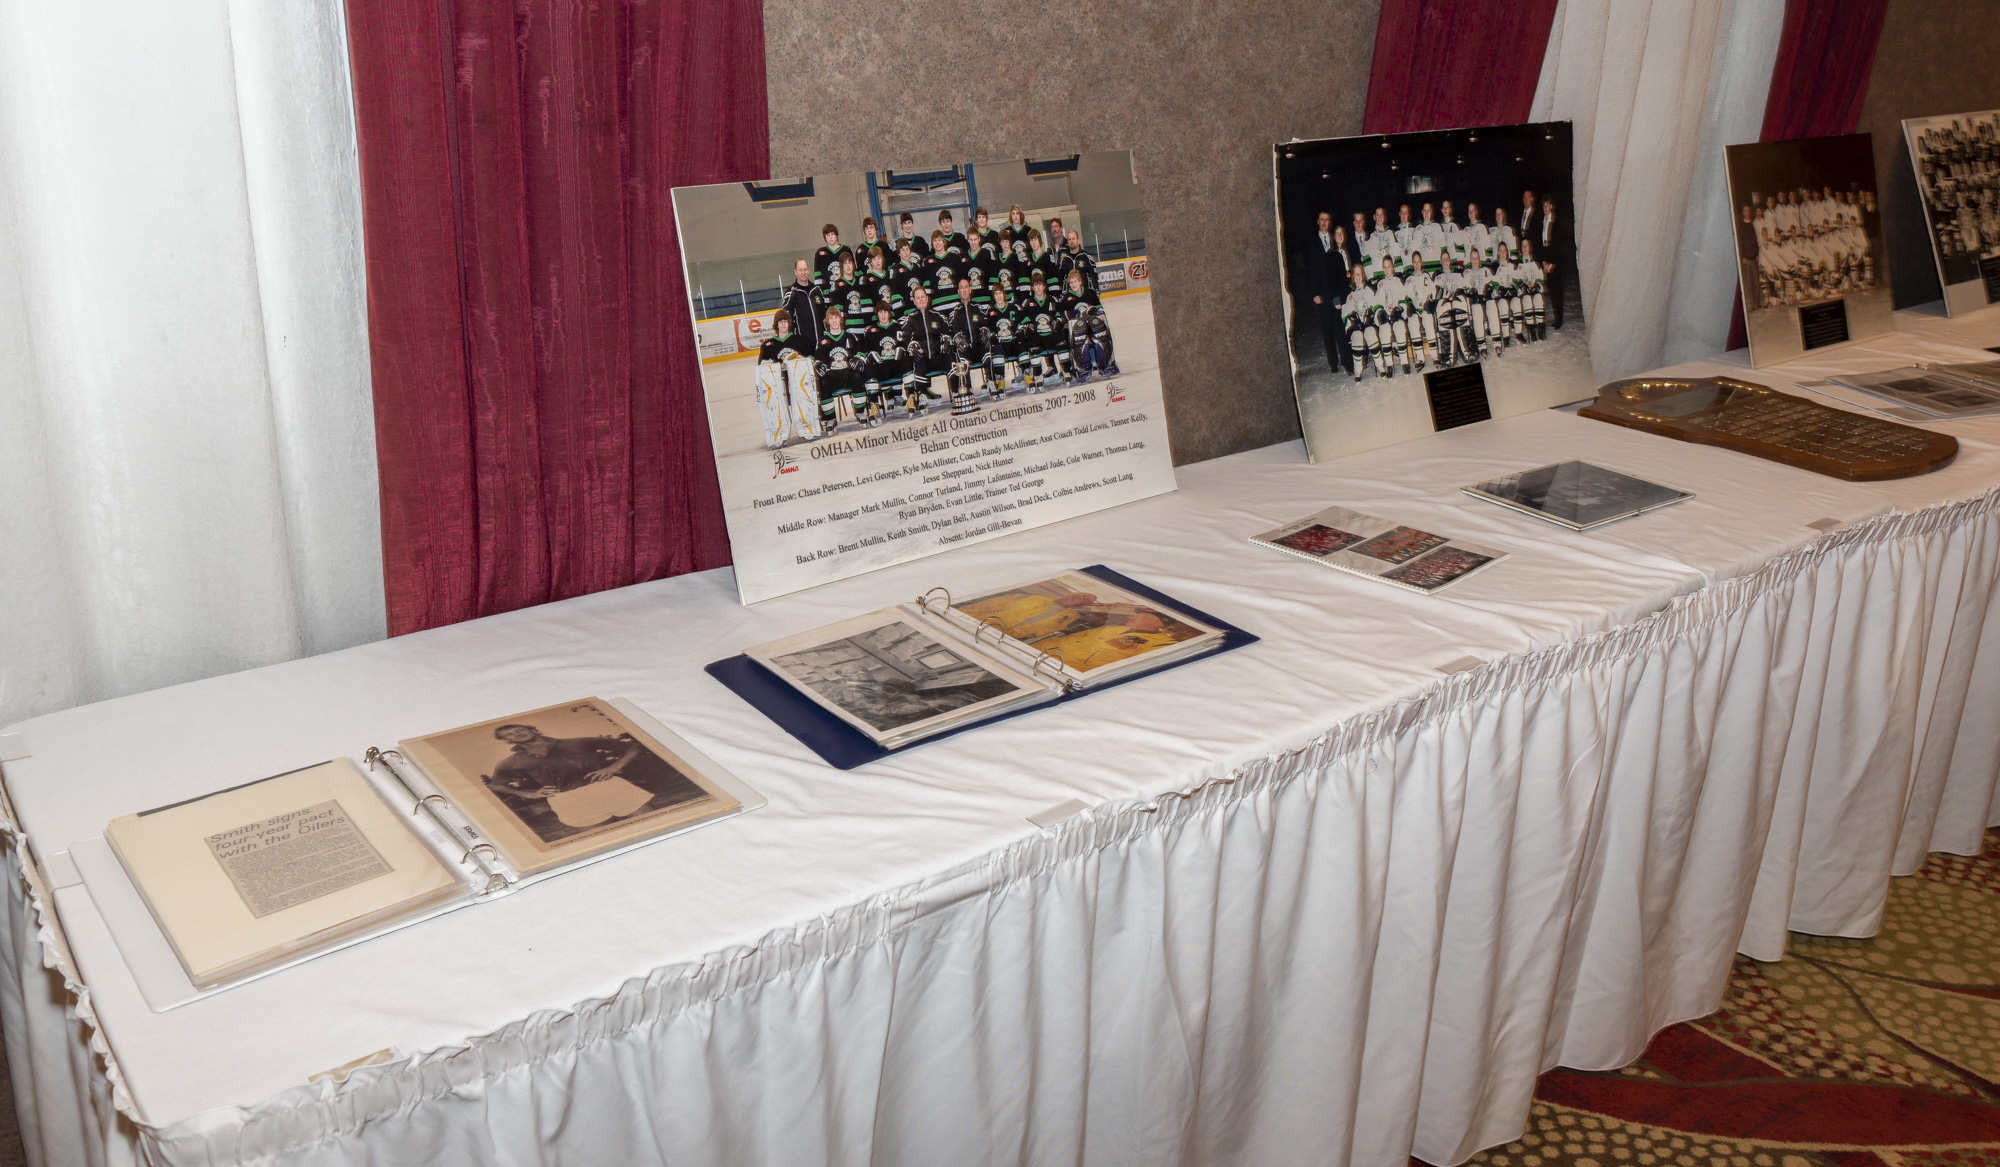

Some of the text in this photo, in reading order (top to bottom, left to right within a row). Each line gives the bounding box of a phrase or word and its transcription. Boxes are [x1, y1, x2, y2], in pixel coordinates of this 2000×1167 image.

[1010, 311, 1015, 320] C
[811, 444, 853, 459] OMHA
[855, 436, 889, 450] Minor
[891, 427, 929, 443] Midget
[931, 420, 947, 434] All
[950, 413, 987, 430] Ontario
[989, 404, 1043, 422] Champions
[1073, 390, 1095, 404] 2008
[921, 428, 1007, 454] Behan Construction
[754, 498, 774, 508] Front
[776, 494, 797, 503] Row:
[798, 488, 821, 498] Chase
[822, 481, 855, 493] Petersen,
[856, 476, 873, 485] Levi
[874, 470, 901, 481] George,
[903, 464, 919, 475] Kyle
[921, 457, 958, 470] McAllister,
[959, 450, 981, 461] Coach
[982, 446, 1001, 456] Randy
[1003, 439, 1038, 451] McAllister,
[1040, 435, 1052, 443] Asst
[1053, 430, 1073, 440] Coach
[1074, 425, 1089, 435] Todd
[1131, 414, 1147, 423] Kelly,
[780, 466, 799, 474] OMHA
[923, 475, 940, 484] Jesse
[941, 466, 974, 479] Sheppard,
[975, 462, 991, 470] Nick
[778, 521, 804, 533] Middle
[806, 519, 827, 527] Row:
[828, 509, 859, 522] Manager
[861, 503, 880, 514] Mark
[882, 498, 907, 509] Mullin,
[908, 491, 934, 502] Connor
[935, 483, 963, 496] Turland,
[964, 480, 985, 489] Jimmy
[1024, 462, 1048, 474] Michael
[1050, 459, 1065, 469] Jude,
[1066, 455, 1080, 464] Cole
[1105, 446, 1128, 455] Thomas
[899, 479, 1043, 520] Ryan Bryden, Evan Little, Trainer Ted George
[797, 552, 816, 564] Back
[817, 550, 838, 559] Row:
[838, 543, 859, 553] Brent
[859, 536, 886, 547] Mullin,
[887, 529, 907, 541] Keith
[908, 524, 930, 535] Smith,
[931, 519, 952, 530] Dylan
[953, 513, 969, 524] Bell,
[970, 509, 991, 519] Austin
[991, 504, 1016, 513] Wilson,
[1017, 497, 1033, 507] Brad
[1034, 493, 1051, 503] Deck,
[1074, 482, 1101, 493] Andrews,
[1102, 477, 1117, 485] Scott
[1118, 473, 1133, 481] Lang
[939, 519, 1022, 544] Absent: Jordan Gill-Bevan
[210, 808, 310, 843] Smith signs
[215, 809, 334, 850] four-year pact
[219, 816, 345, 859] with the Oilers
